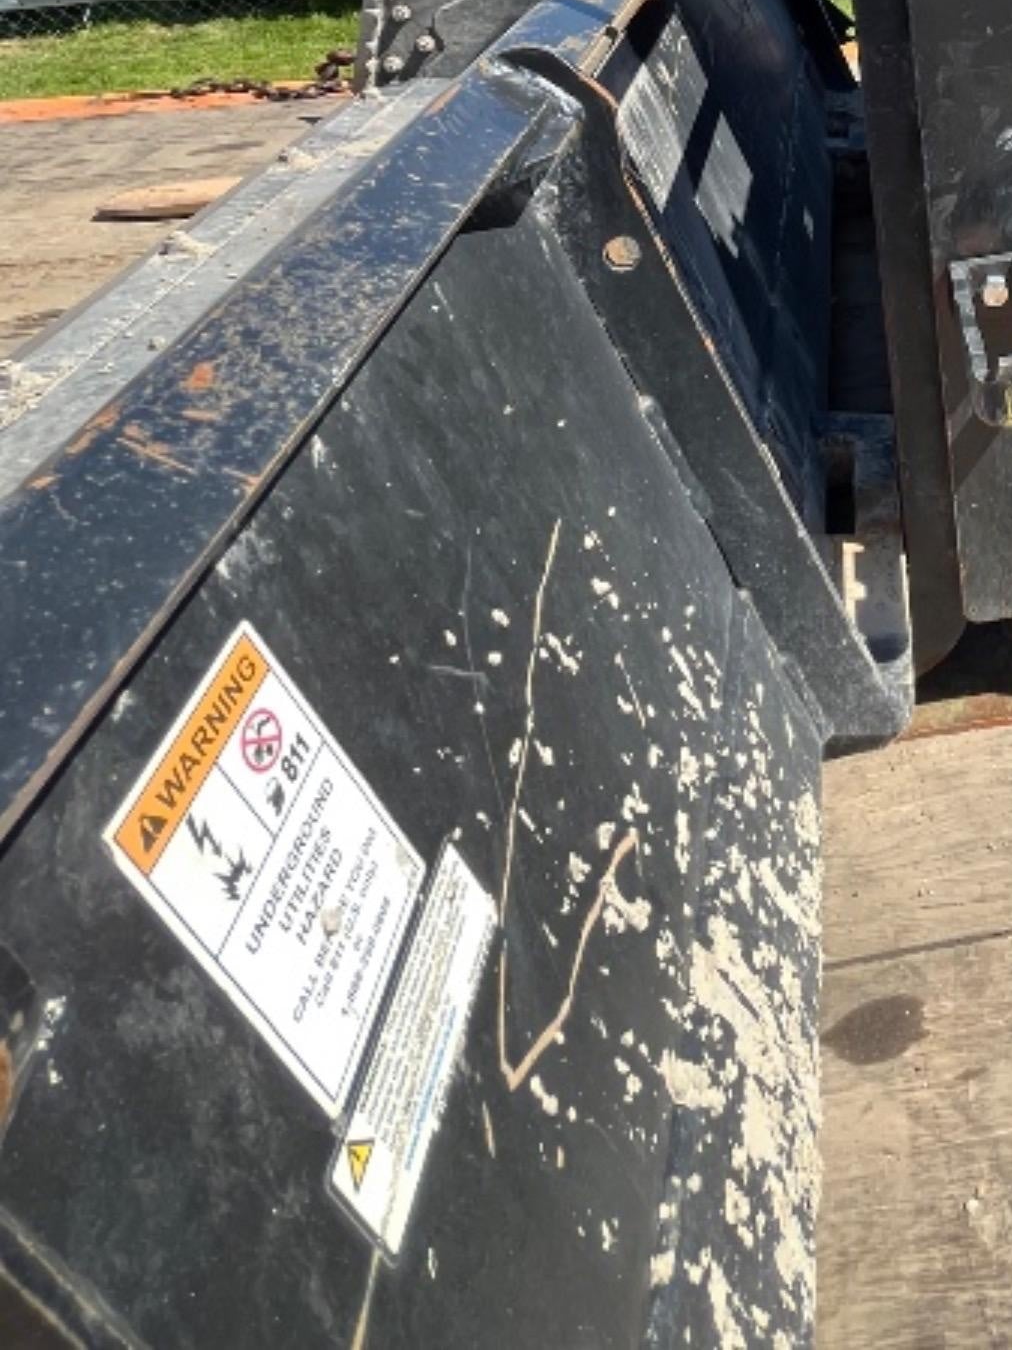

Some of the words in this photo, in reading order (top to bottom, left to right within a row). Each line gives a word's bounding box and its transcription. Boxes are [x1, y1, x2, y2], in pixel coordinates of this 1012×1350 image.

[156, 652, 258, 811] WARNING
[279, 733, 312, 783] 811
[246, 776, 335, 955] UNDERGROUND
[277, 824, 331, 934] UTILITIES
[296, 847, 342, 946] HAZARD
